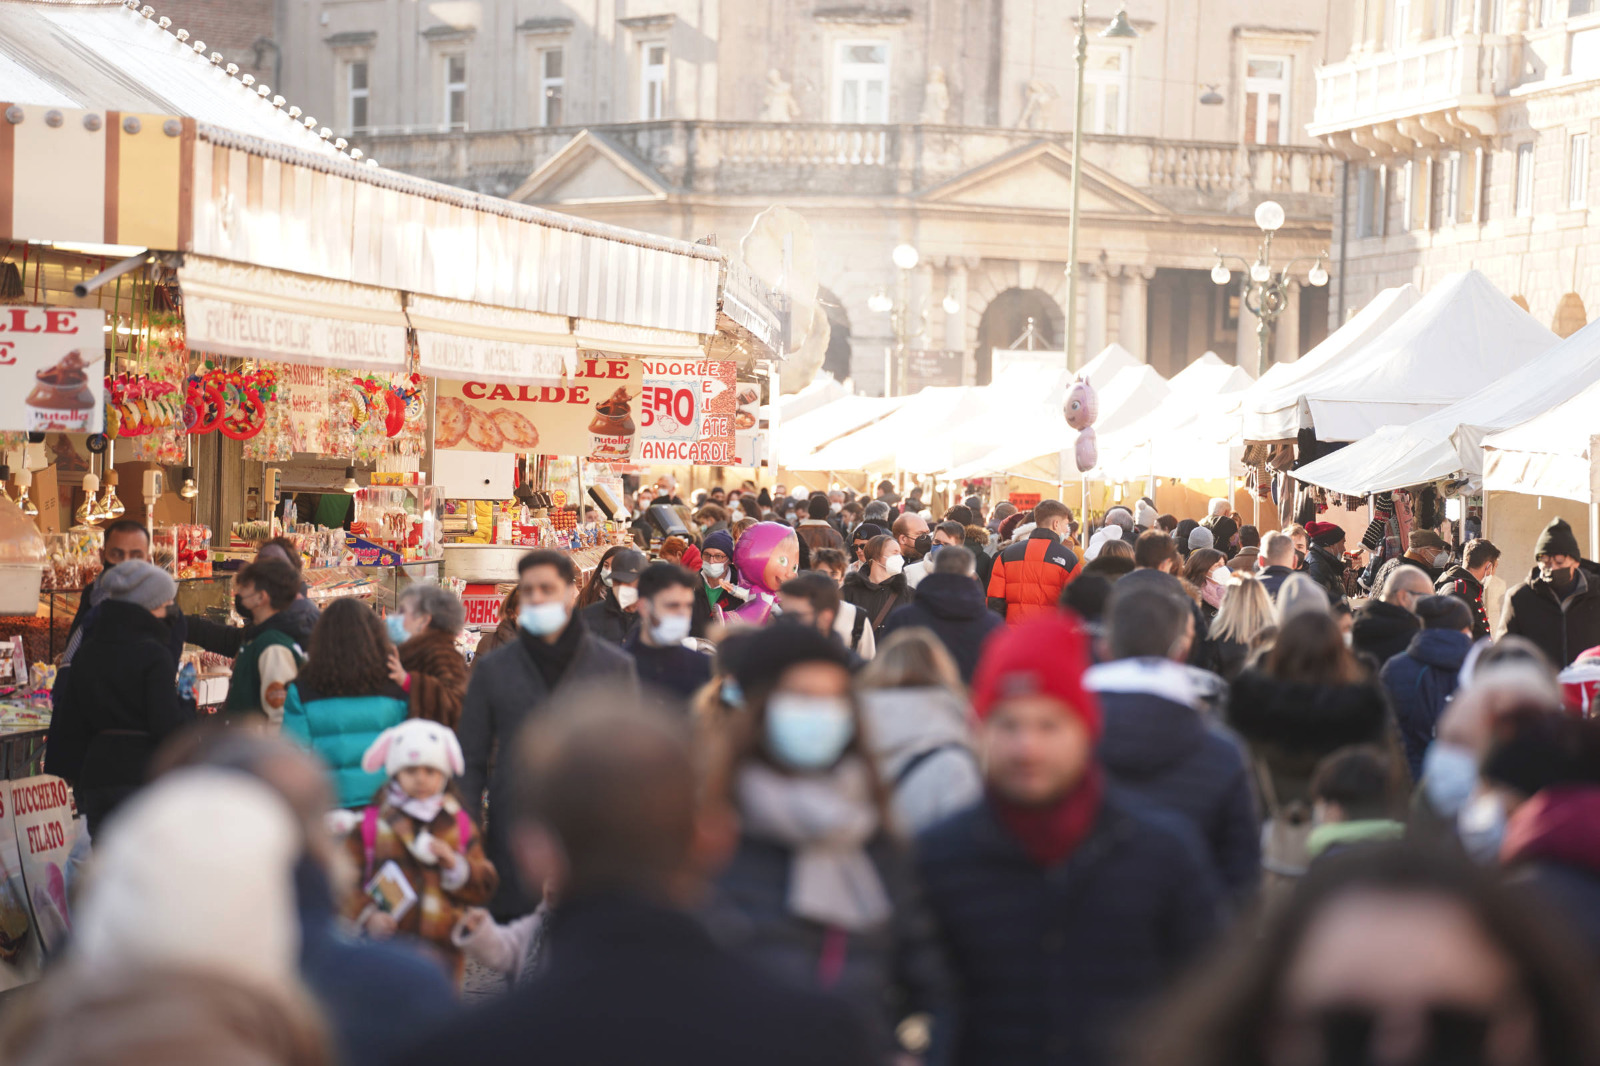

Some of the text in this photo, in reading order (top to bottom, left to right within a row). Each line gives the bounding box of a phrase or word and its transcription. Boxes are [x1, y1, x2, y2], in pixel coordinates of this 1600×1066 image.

[0, 308, 79, 335] LE
[462, 381, 590, 405] CALDE
[34, 409, 89, 422] nutella
[594, 435, 631, 445] nutella
[12, 779, 68, 816] ZUCCHERO
[26, 820, 65, 854] FILATO
